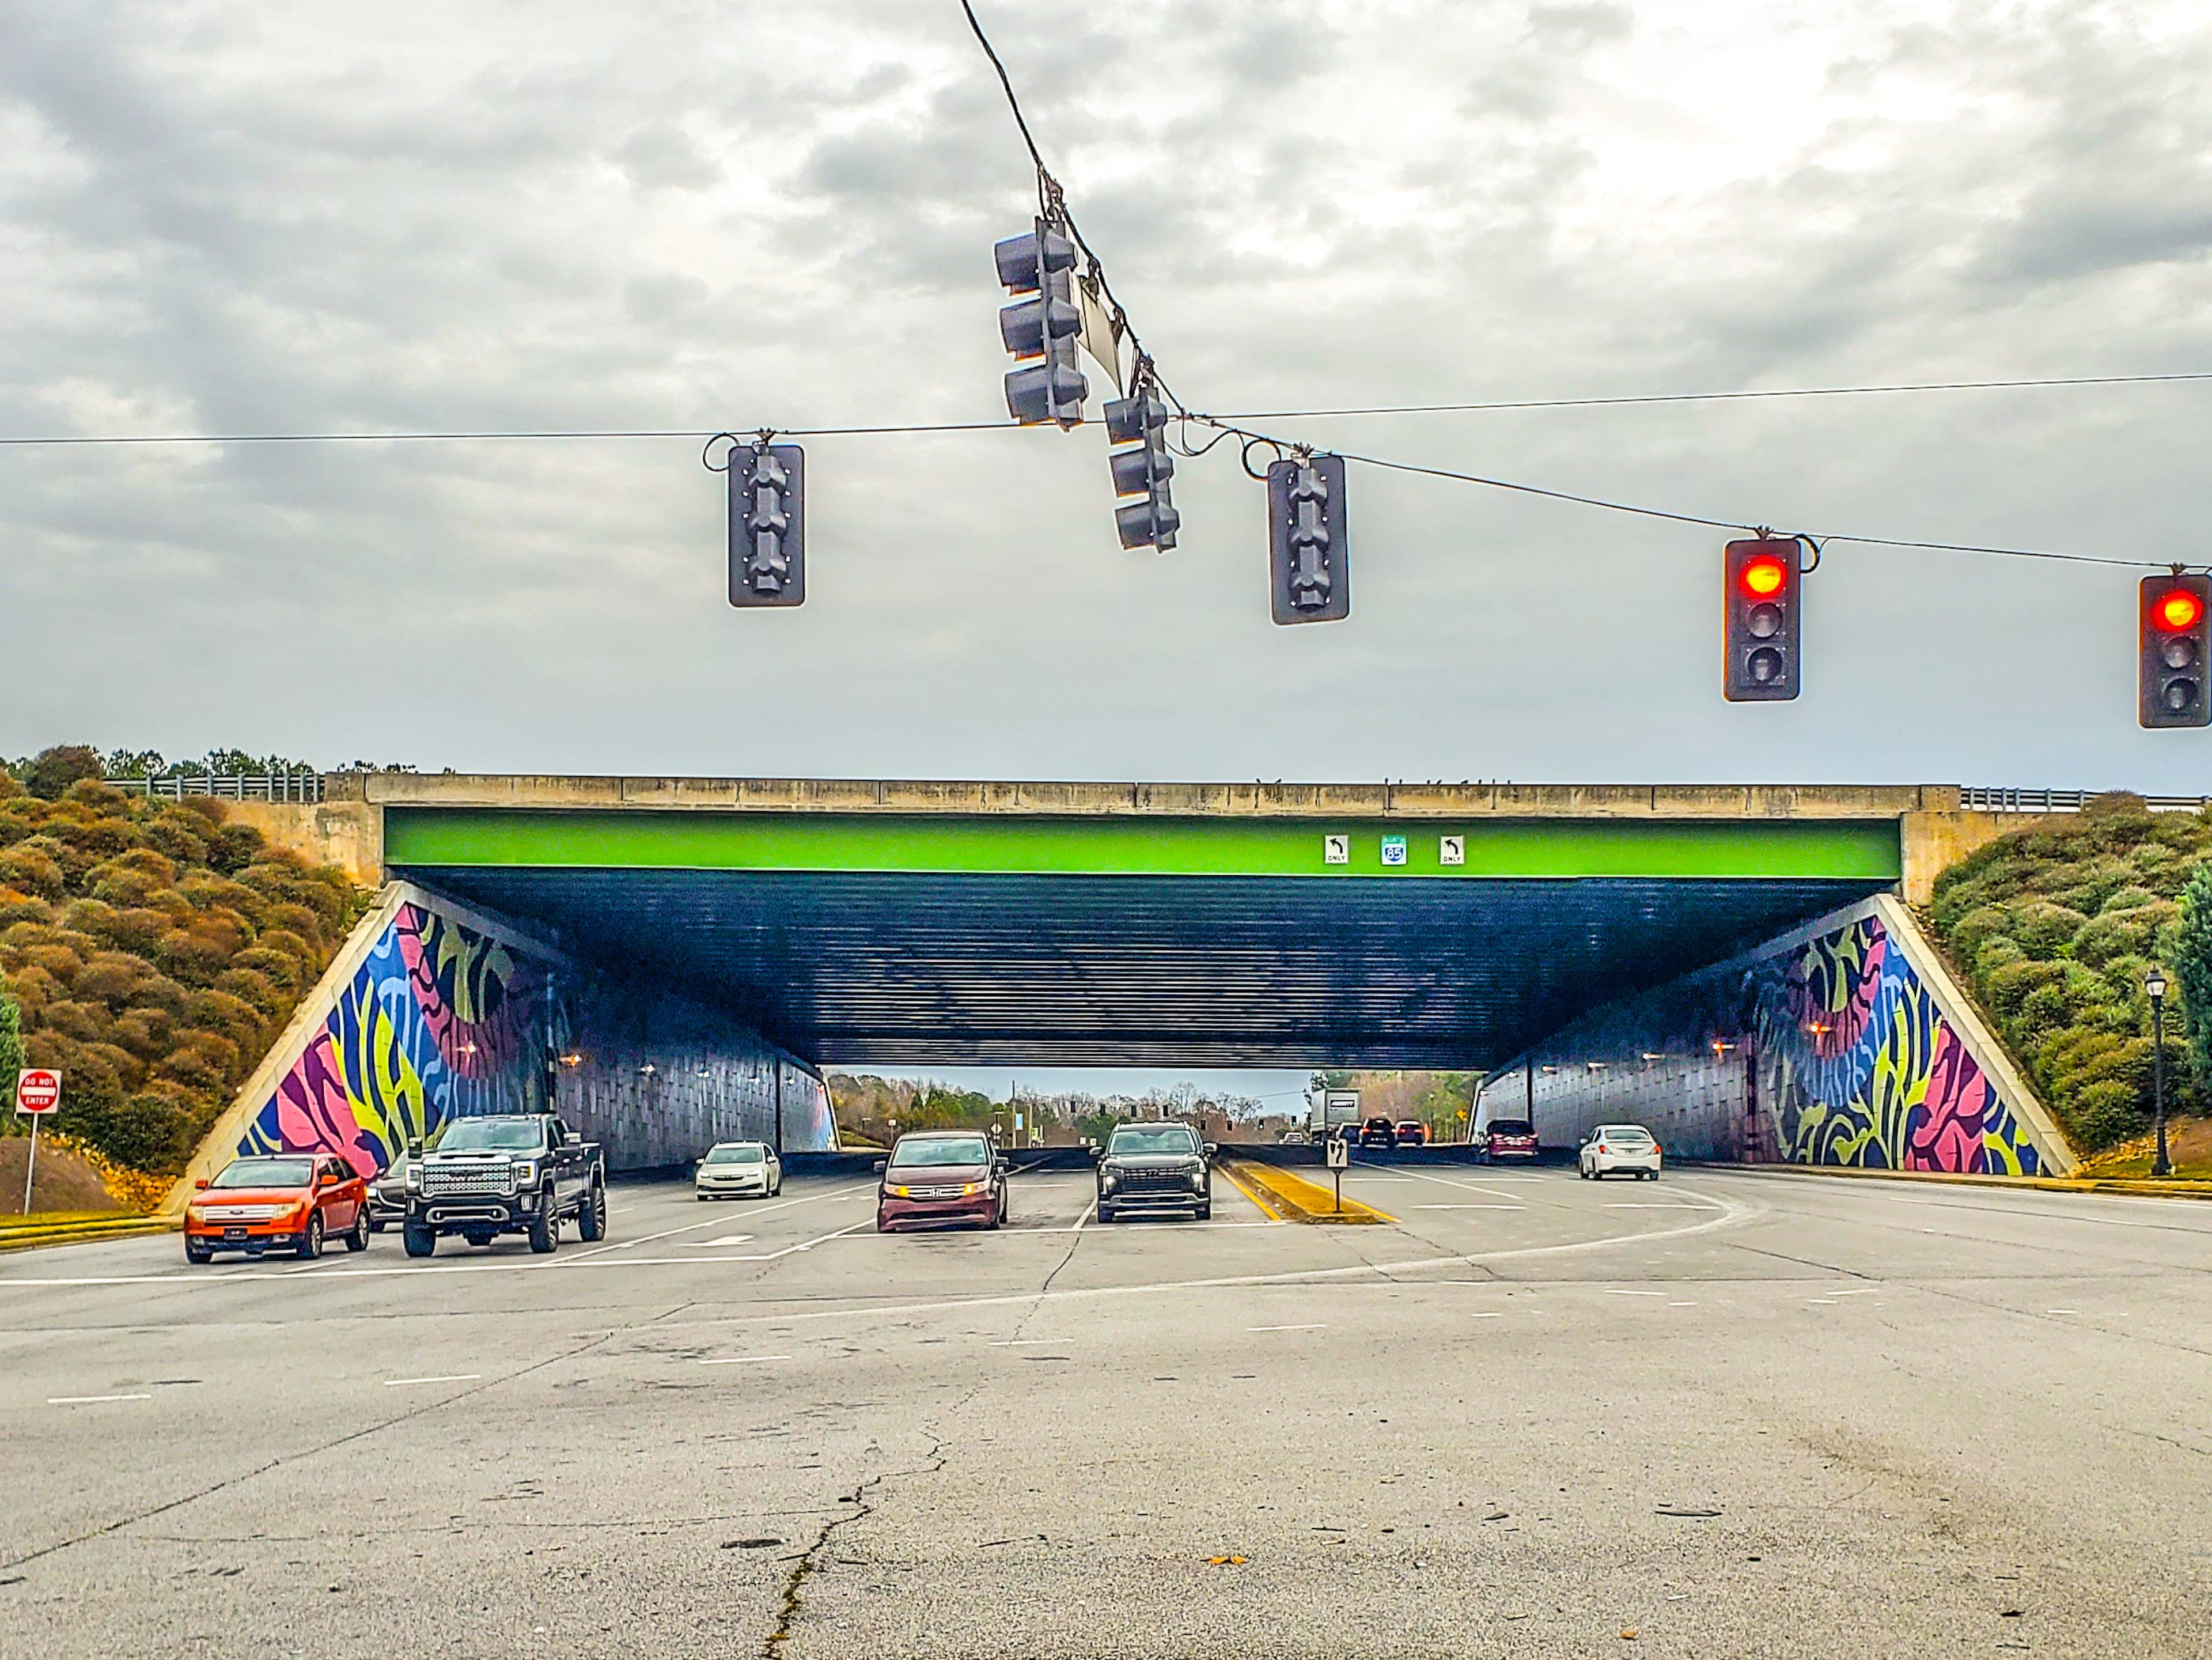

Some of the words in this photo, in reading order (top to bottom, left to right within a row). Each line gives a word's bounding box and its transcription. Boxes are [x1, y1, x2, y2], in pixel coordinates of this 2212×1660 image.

[1387, 848, 1402, 859] 85
[25, 1077, 36, 1086] DO
[39, 1078, 54, 1086] NOT
[25, 1096, 50, 1105] ENTER
